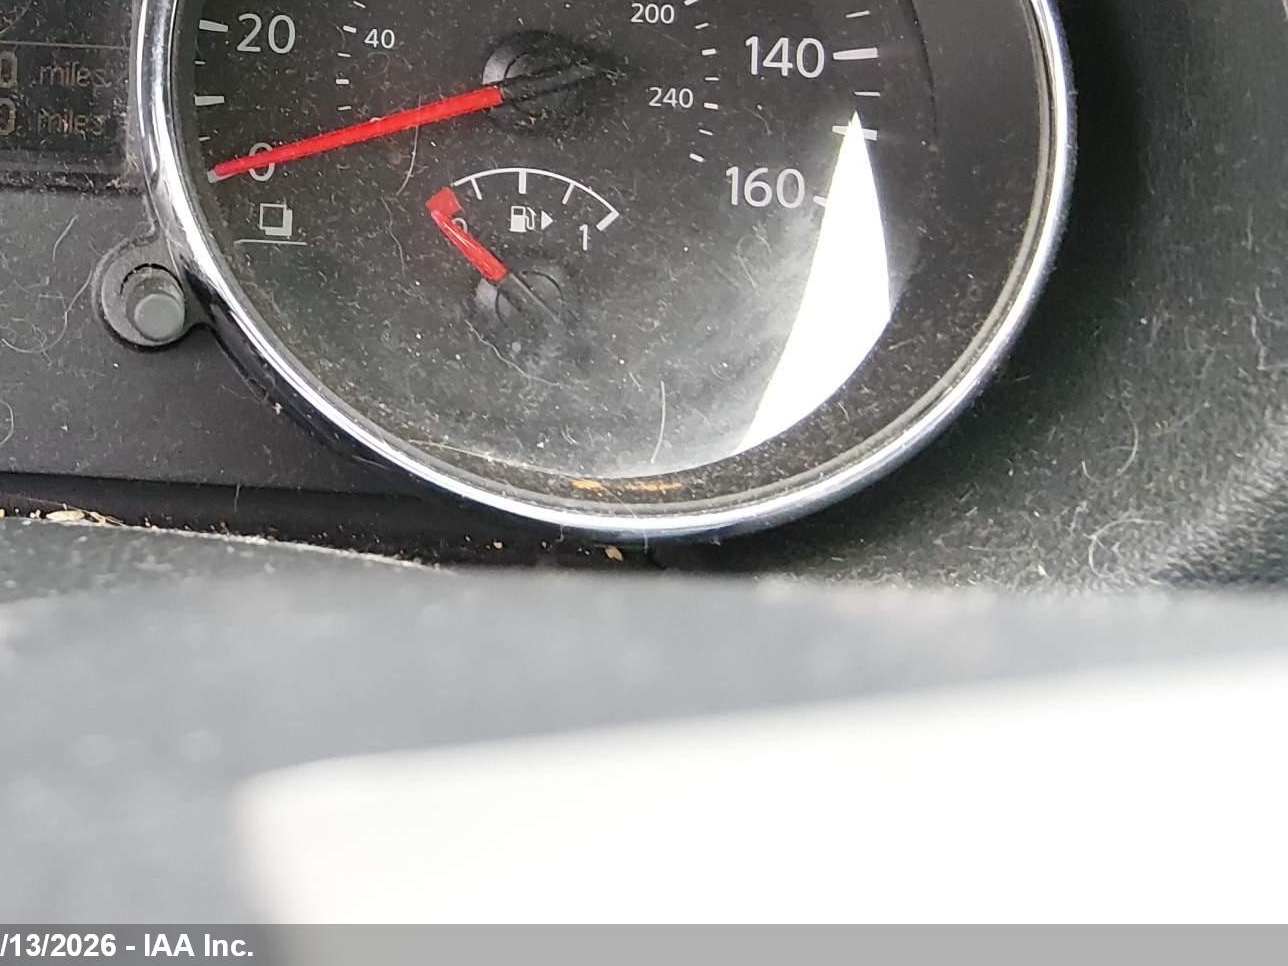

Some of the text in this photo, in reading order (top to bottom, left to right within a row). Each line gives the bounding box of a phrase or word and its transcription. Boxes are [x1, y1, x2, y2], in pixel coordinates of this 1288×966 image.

[630, 2, 675, 24] 200
[236, 13, 296, 54] 20
[363, 28, 396, 49] 40
[745, 36, 825, 78] 140
[38, 61, 113, 89] miles
[648, 86, 694, 109] 240
[36, 107, 106, 136] miles
[248, 141, 276, 182] 0
[725, 166, 806, 209] 160
[579, 224, 591, 251] 1
